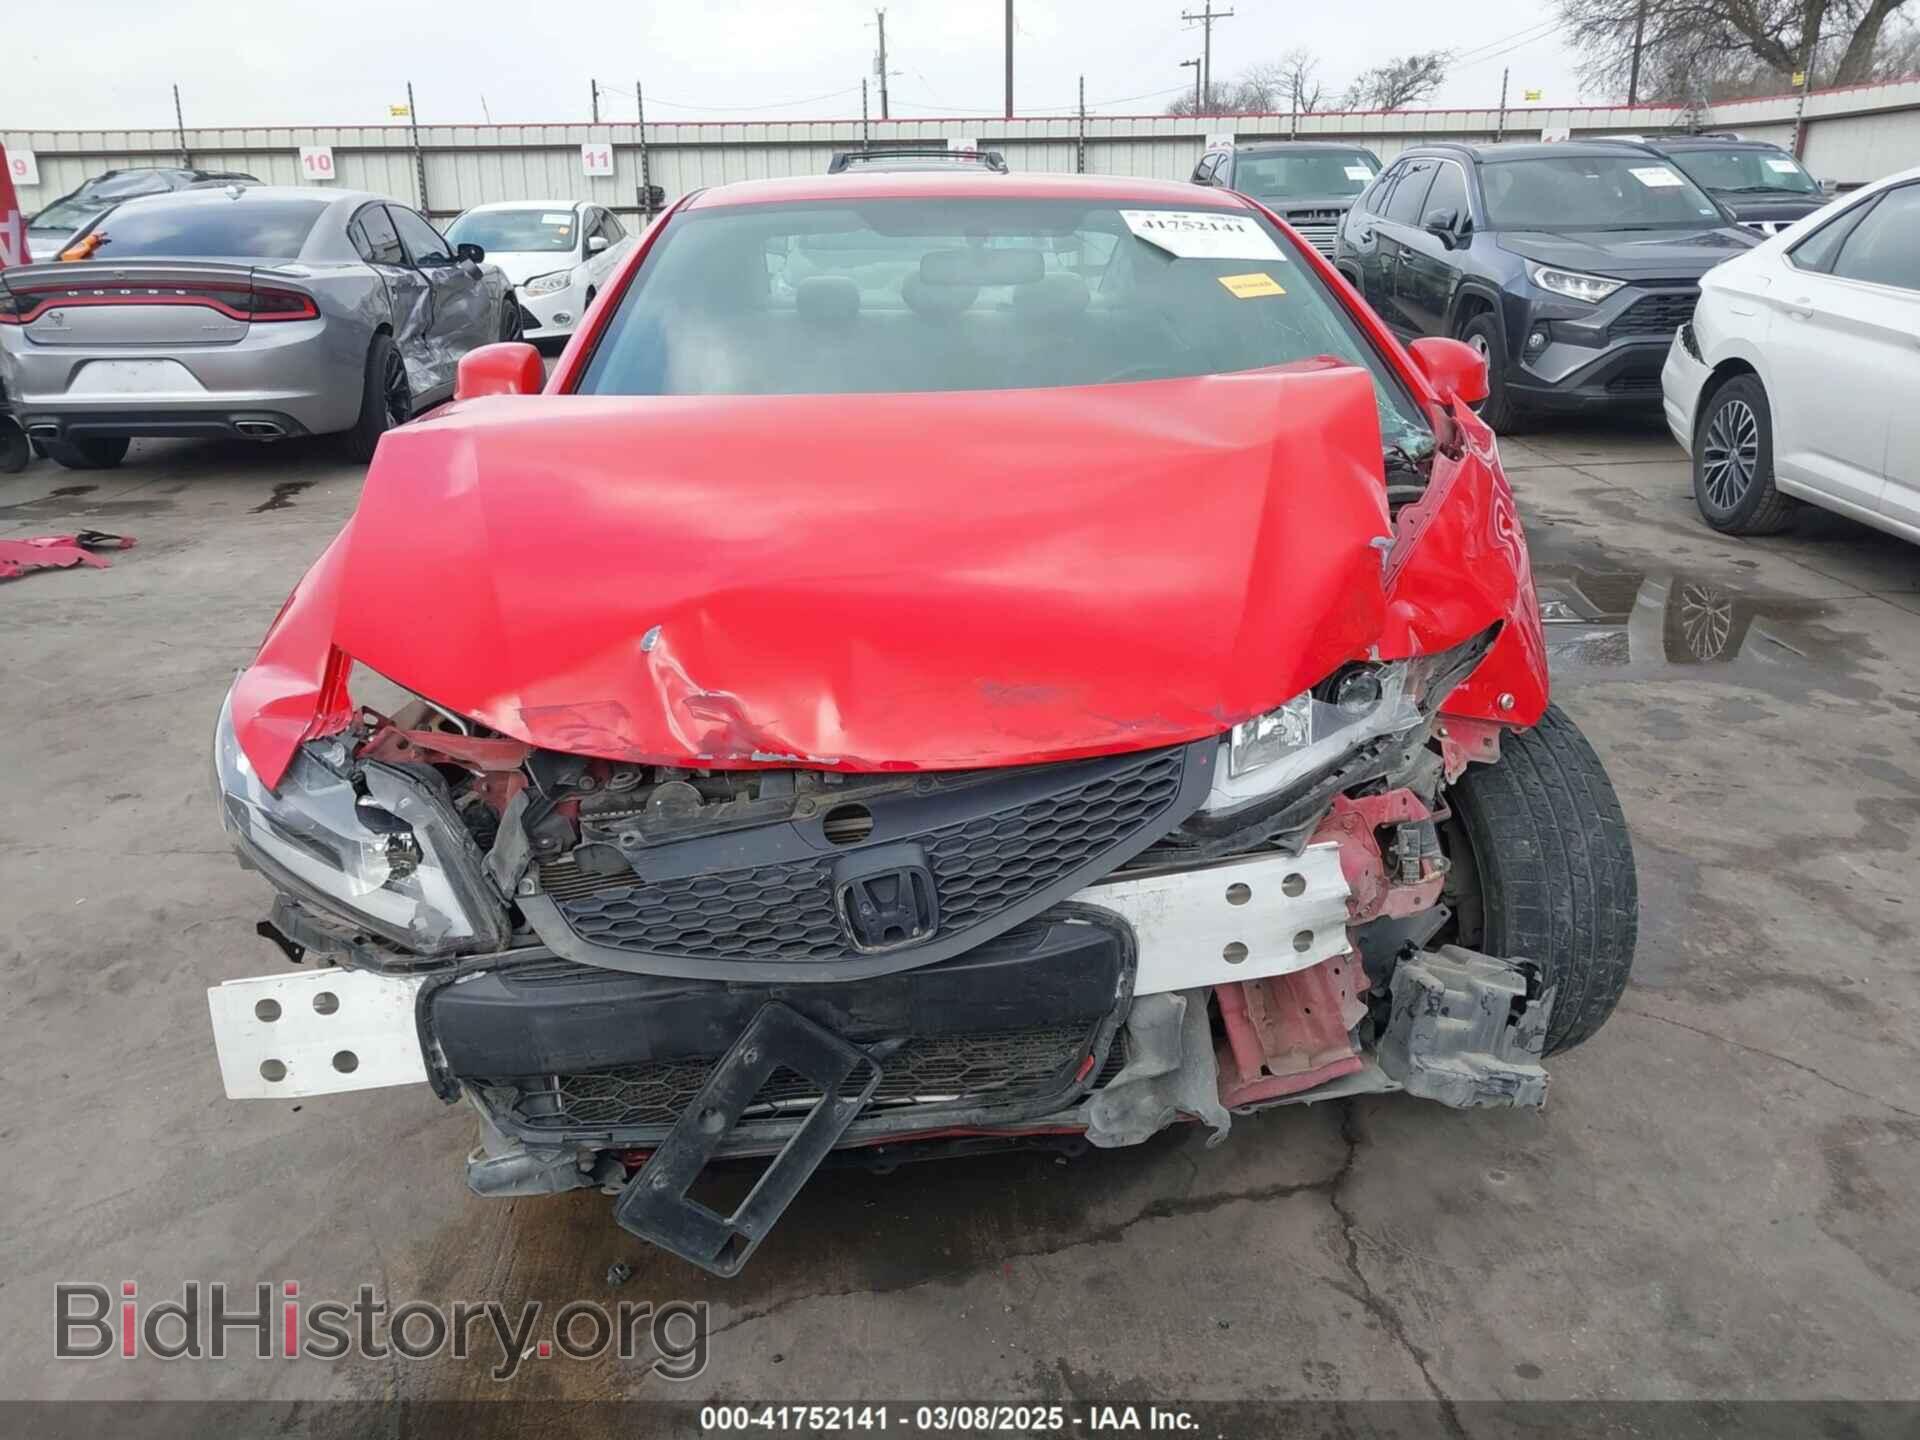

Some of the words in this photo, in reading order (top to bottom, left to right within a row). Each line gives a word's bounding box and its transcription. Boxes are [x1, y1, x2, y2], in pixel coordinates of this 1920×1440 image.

[13, 159, 27, 176] 9
[304, 154, 331, 171] 10
[585, 151, 609, 168] 11
[1142, 220, 1246, 233] 41752141
